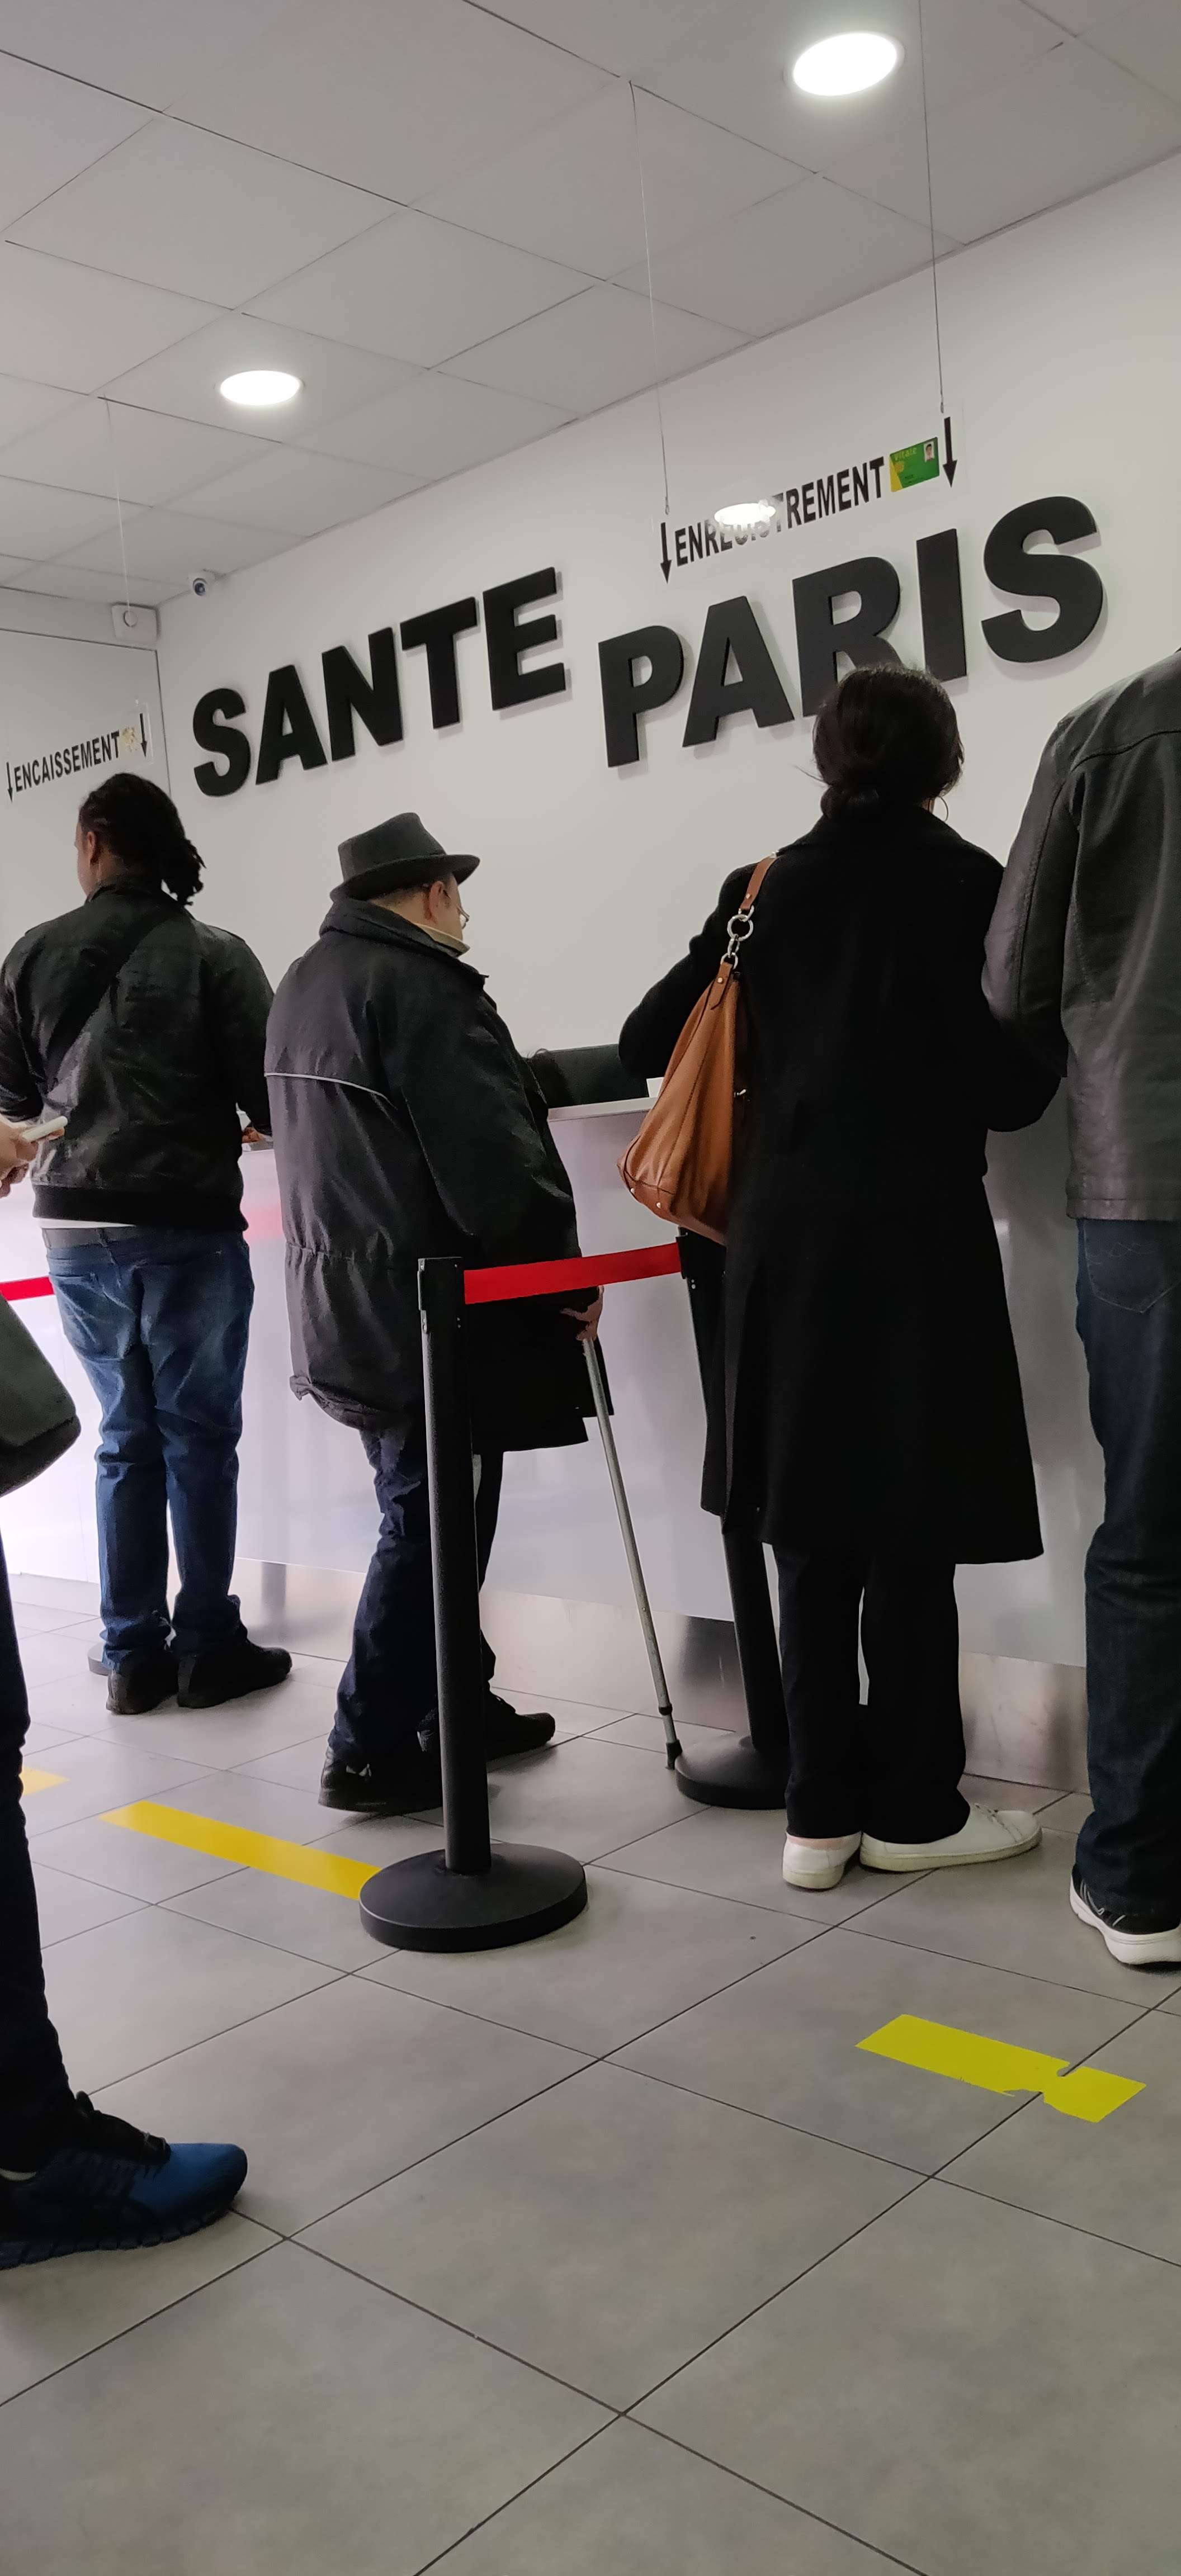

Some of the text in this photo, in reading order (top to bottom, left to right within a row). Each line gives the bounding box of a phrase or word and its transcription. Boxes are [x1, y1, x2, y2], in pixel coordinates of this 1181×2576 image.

[192, 495, 1103, 797] SANTE PARIS
[14, 730, 120, 792] ENCAISSEMENT
